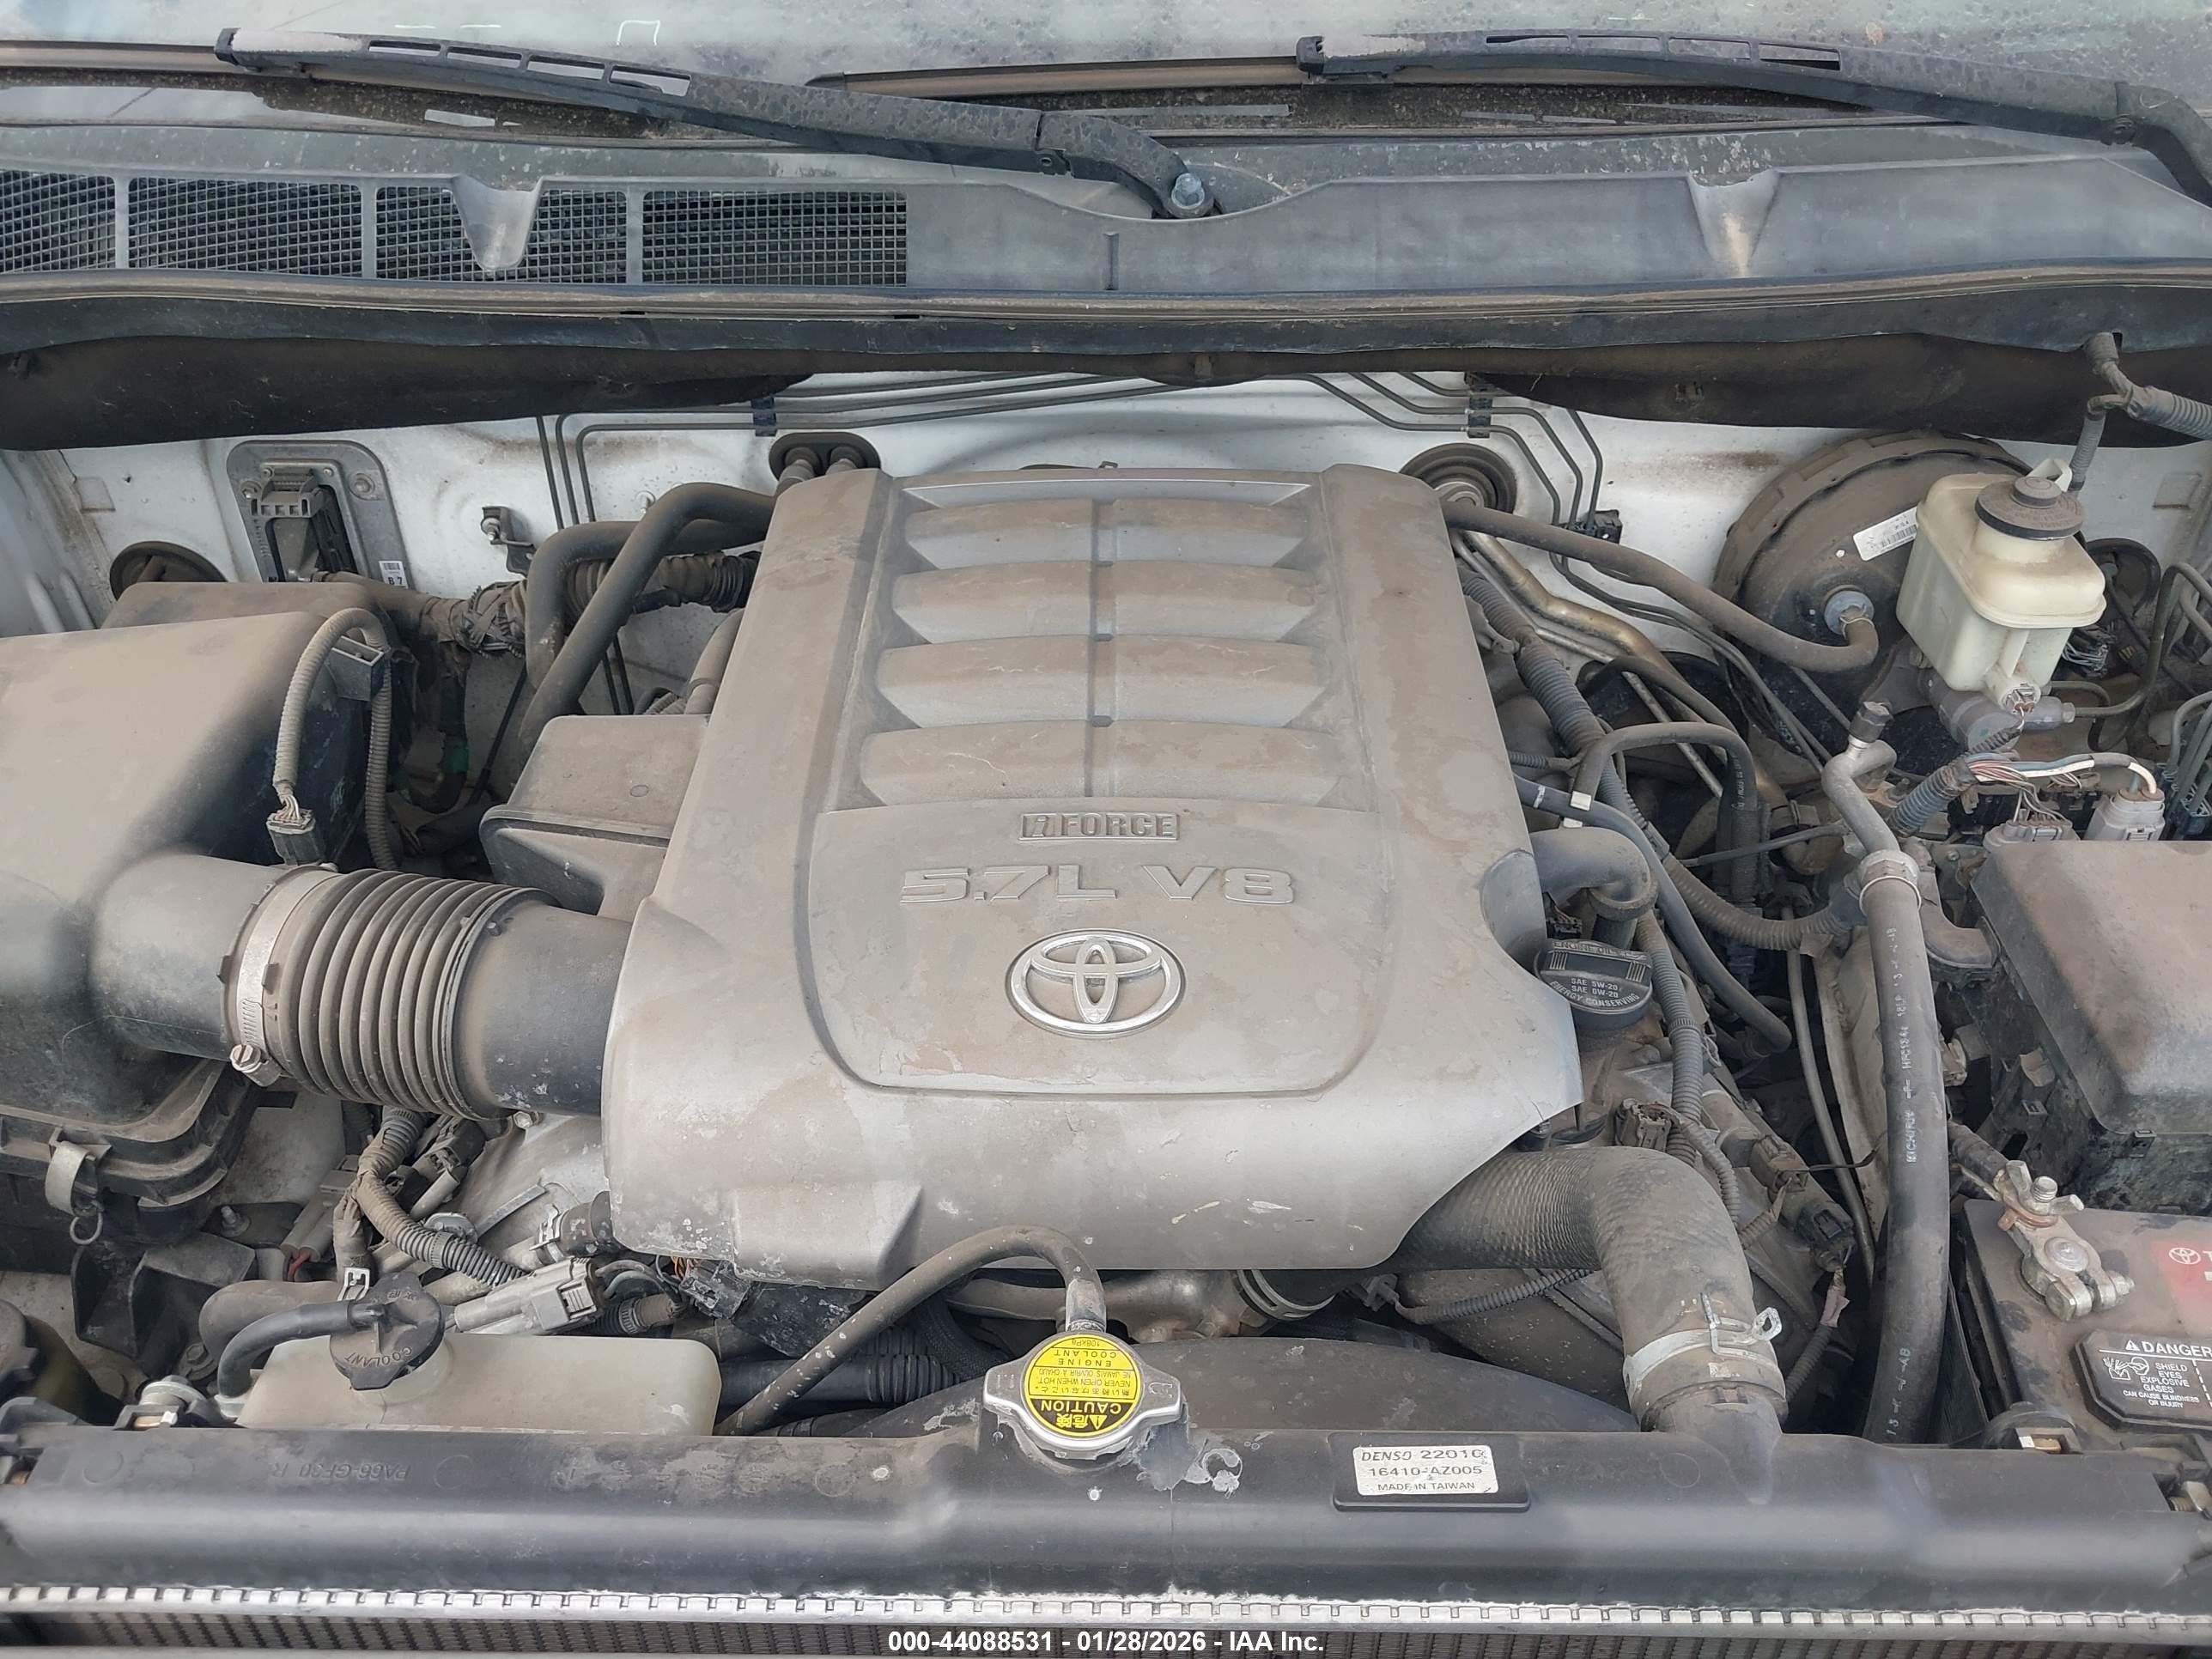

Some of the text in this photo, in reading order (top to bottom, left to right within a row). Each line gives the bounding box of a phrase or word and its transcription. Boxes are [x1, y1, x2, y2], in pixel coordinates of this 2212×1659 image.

[1060, 812, 1176, 836] FORCE
[899, 864, 1295, 906] 5.7L V8
[1591, 981, 1619, 991] 5W-20
[1549, 981, 1640, 1007] ENERGY CONSERVING
[1592, 988, 1619, 998] 0W-20
[1072, 1339, 1101, 1348] 108kPa
[344, 1346, 412, 1367] COOLANT
[1054, 1350, 1116, 1358] COOLANT
[1058, 1358, 1112, 1367] ENGINE
[2155, 1362, 2188, 1372] SHIELD
[2158, 1370, 2183, 1380] EYES
[2140, 1376, 2191, 1388] EXPLOSIVE
[2143, 1384, 2174, 1394] GASES
[2123, 1389, 2200, 1403] CAN CAUSE BLINDNESS
[1041, 1400, 1121, 1414] CAUTION
[2148, 1398, 2184, 1408] OR INJURY
[1056, 1413, 1089, 1429] 危険
[1361, 1450, 1412, 1462] DENSO
[1369, 1466, 1482, 1477] 16410-AZ005
[1414, 1482, 1426, 1491] IN
[1431, 1482, 1475, 1491] TAIWAN
